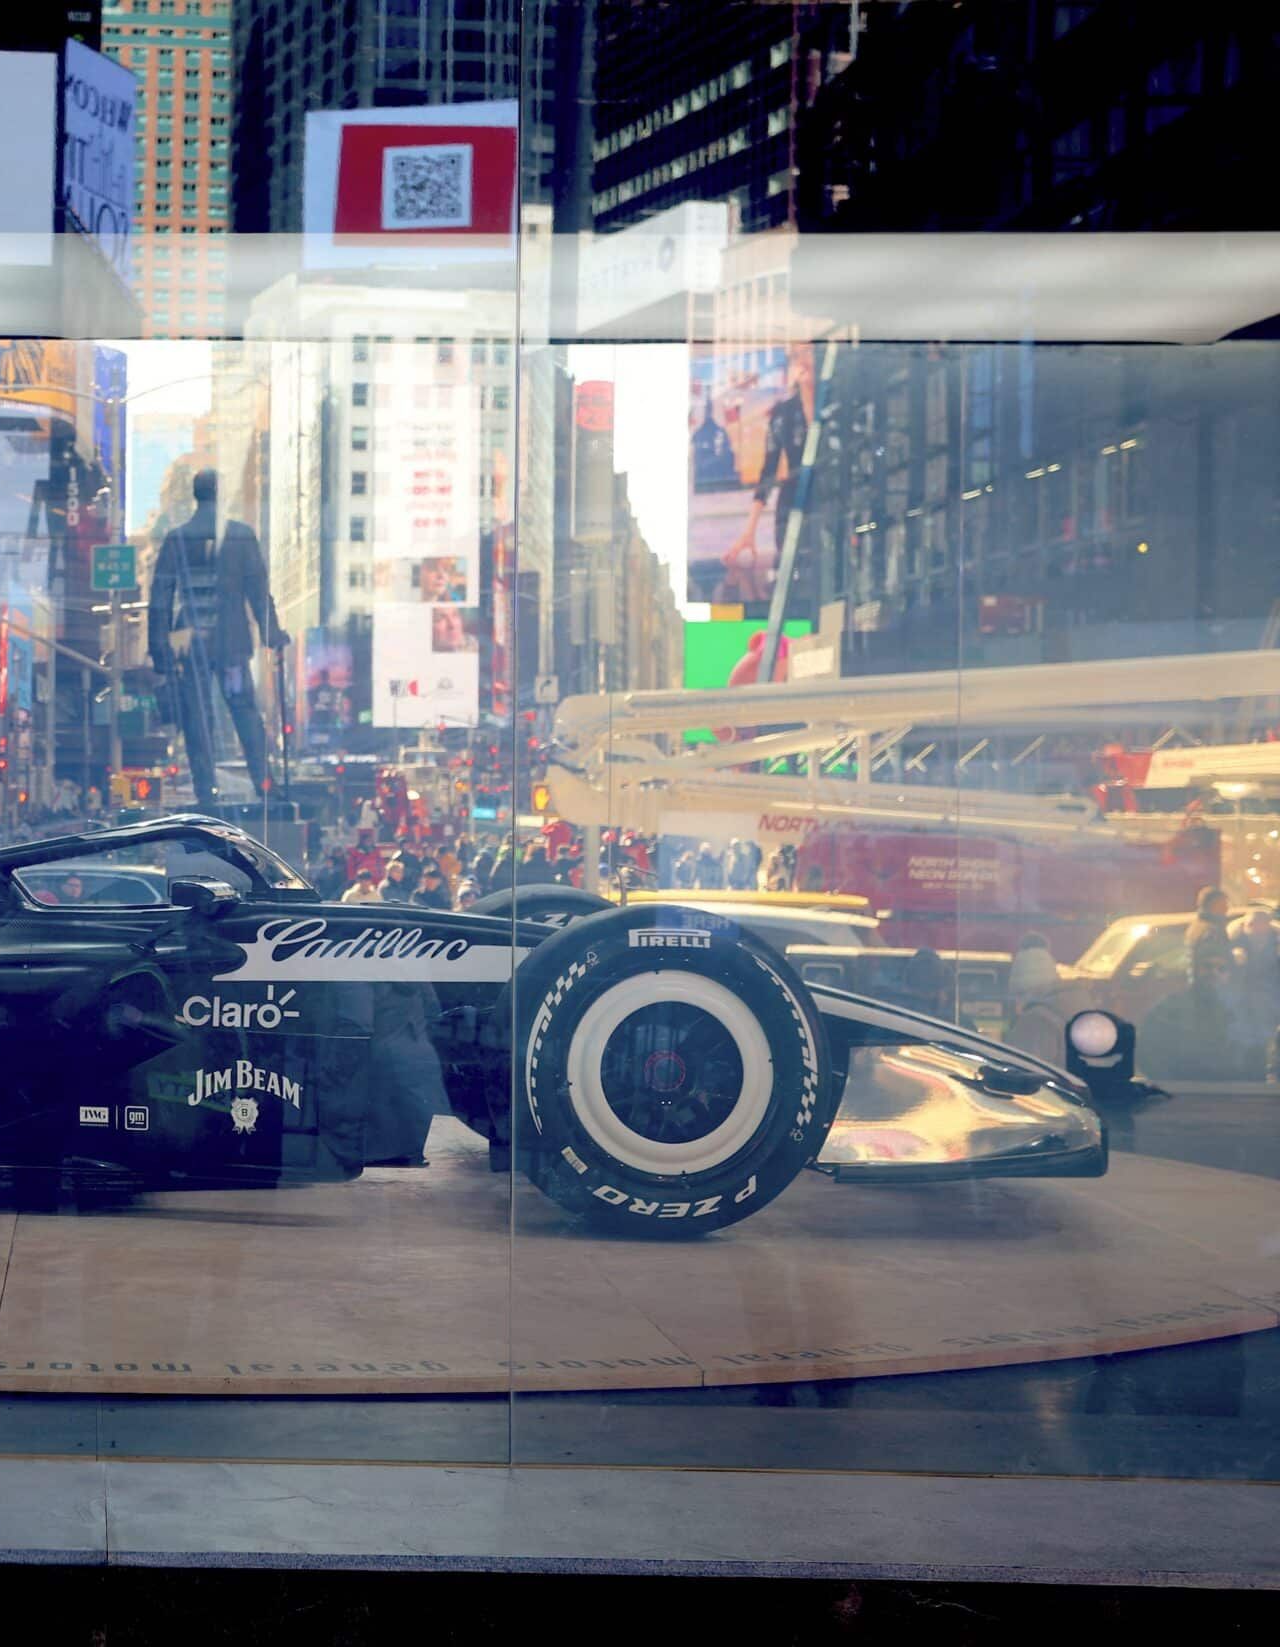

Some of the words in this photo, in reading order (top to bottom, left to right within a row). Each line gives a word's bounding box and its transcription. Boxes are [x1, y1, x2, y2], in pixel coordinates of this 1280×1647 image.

[256, 918, 476, 962] Cadillac
[628, 928, 712, 949] PIRELLI
[182, 995, 283, 1029] Claro
[188, 1068, 233, 1107] JIM
[236, 1059, 302, 1110] BEAM
[81, 1109, 107, 1120] TWG
[128, 1111, 145, 1125] gm
[592, 1184, 723, 1219] ZERO
[734, 1174, 758, 1204] P
